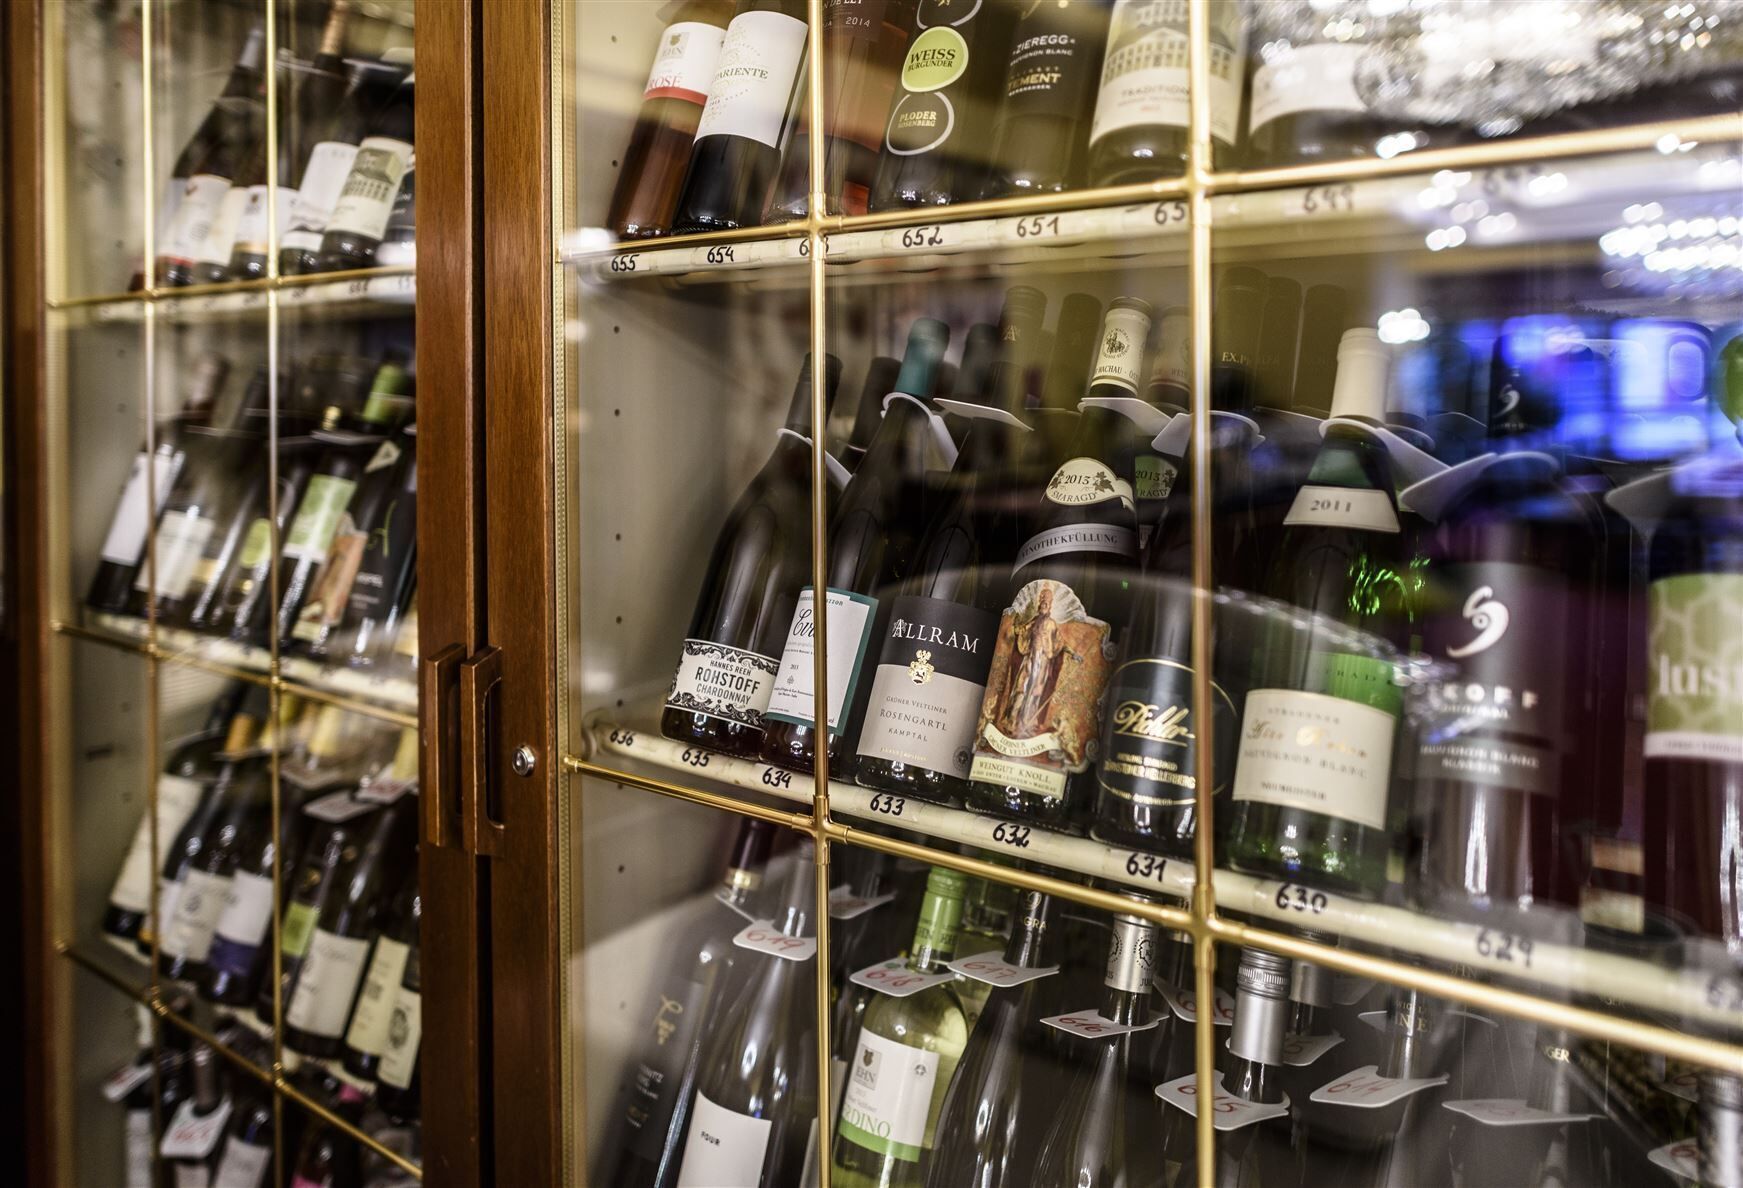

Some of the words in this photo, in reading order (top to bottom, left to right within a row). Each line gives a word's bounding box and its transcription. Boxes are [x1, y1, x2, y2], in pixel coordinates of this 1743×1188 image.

[845, 16, 871, 28] 2014
[1015, 34, 1069, 55] ZIEREGG
[907, 59, 954, 73] BURGUNDER
[910, 48, 956, 63] WEISS
[899, 111, 937, 122] PLODER
[1153, 201, 1187, 227] 65
[902, 226, 944, 249] 652
[1016, 216, 1060, 239] 651
[611, 254, 637, 273] 655
[706, 246, 735, 266] 654
[1309, 498, 1353, 513] 2011
[891, 618, 980, 654] ALLRAM
[710, 660, 733, 671] HANNES
[694, 666, 761, 695] ROHSTOFF
[696, 683, 752, 705] CHARDONNAY
[911, 700, 948, 715] VELTLINER
[879, 708, 948, 732] ROSENGARTL
[609, 728, 635, 747] 636
[888, 727, 928, 742] KAMPTAL
[681, 747, 714, 768] 635
[762, 766, 792, 789] 634
[979, 760, 1015, 774] WEINGUT
[1018, 768, 1050, 783] KNOLL
[869, 793, 906, 817] 633
[992, 822, 1031, 849] 632
[1125, 854, 1167, 883] 631
[1275, 882, 1329, 915] 630
[746, 928, 806, 952] 619
[1475, 924, 1536, 969] 629
[865, 968, 924, 987] 618
[1058, 1016, 1110, 1033] 616
[856, 1066, 876, 1084] EHN
